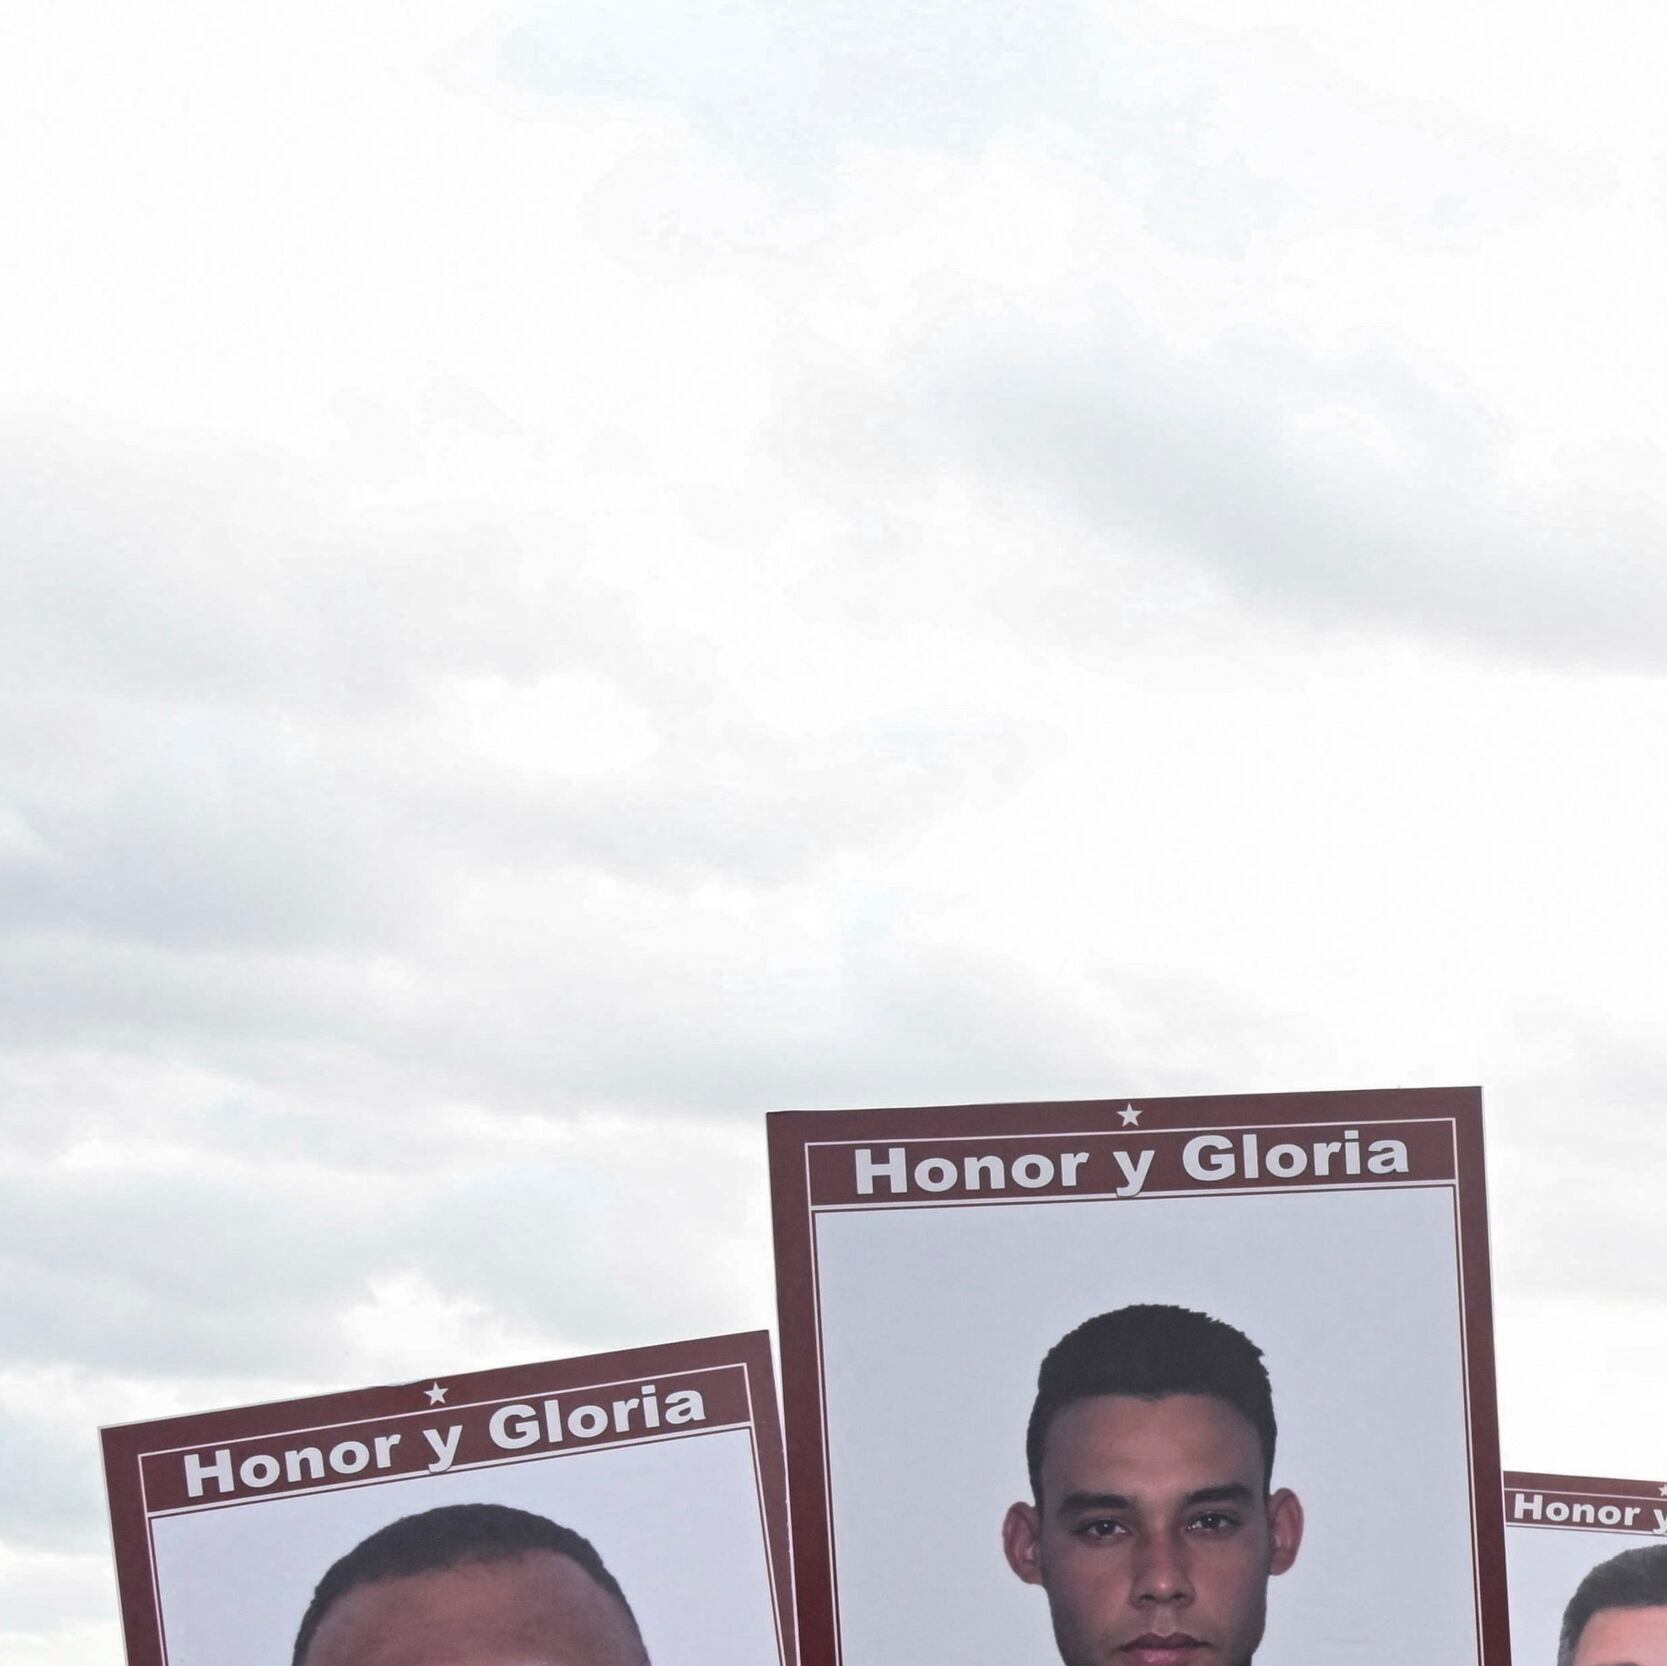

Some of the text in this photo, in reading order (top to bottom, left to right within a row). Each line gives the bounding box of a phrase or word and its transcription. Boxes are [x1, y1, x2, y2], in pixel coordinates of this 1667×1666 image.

[855, 1130, 1410, 1198] Honor y Gloria
[185, 1385, 706, 1498] Honor y Gloria
[1514, 1493, 1642, 1526] Honor
